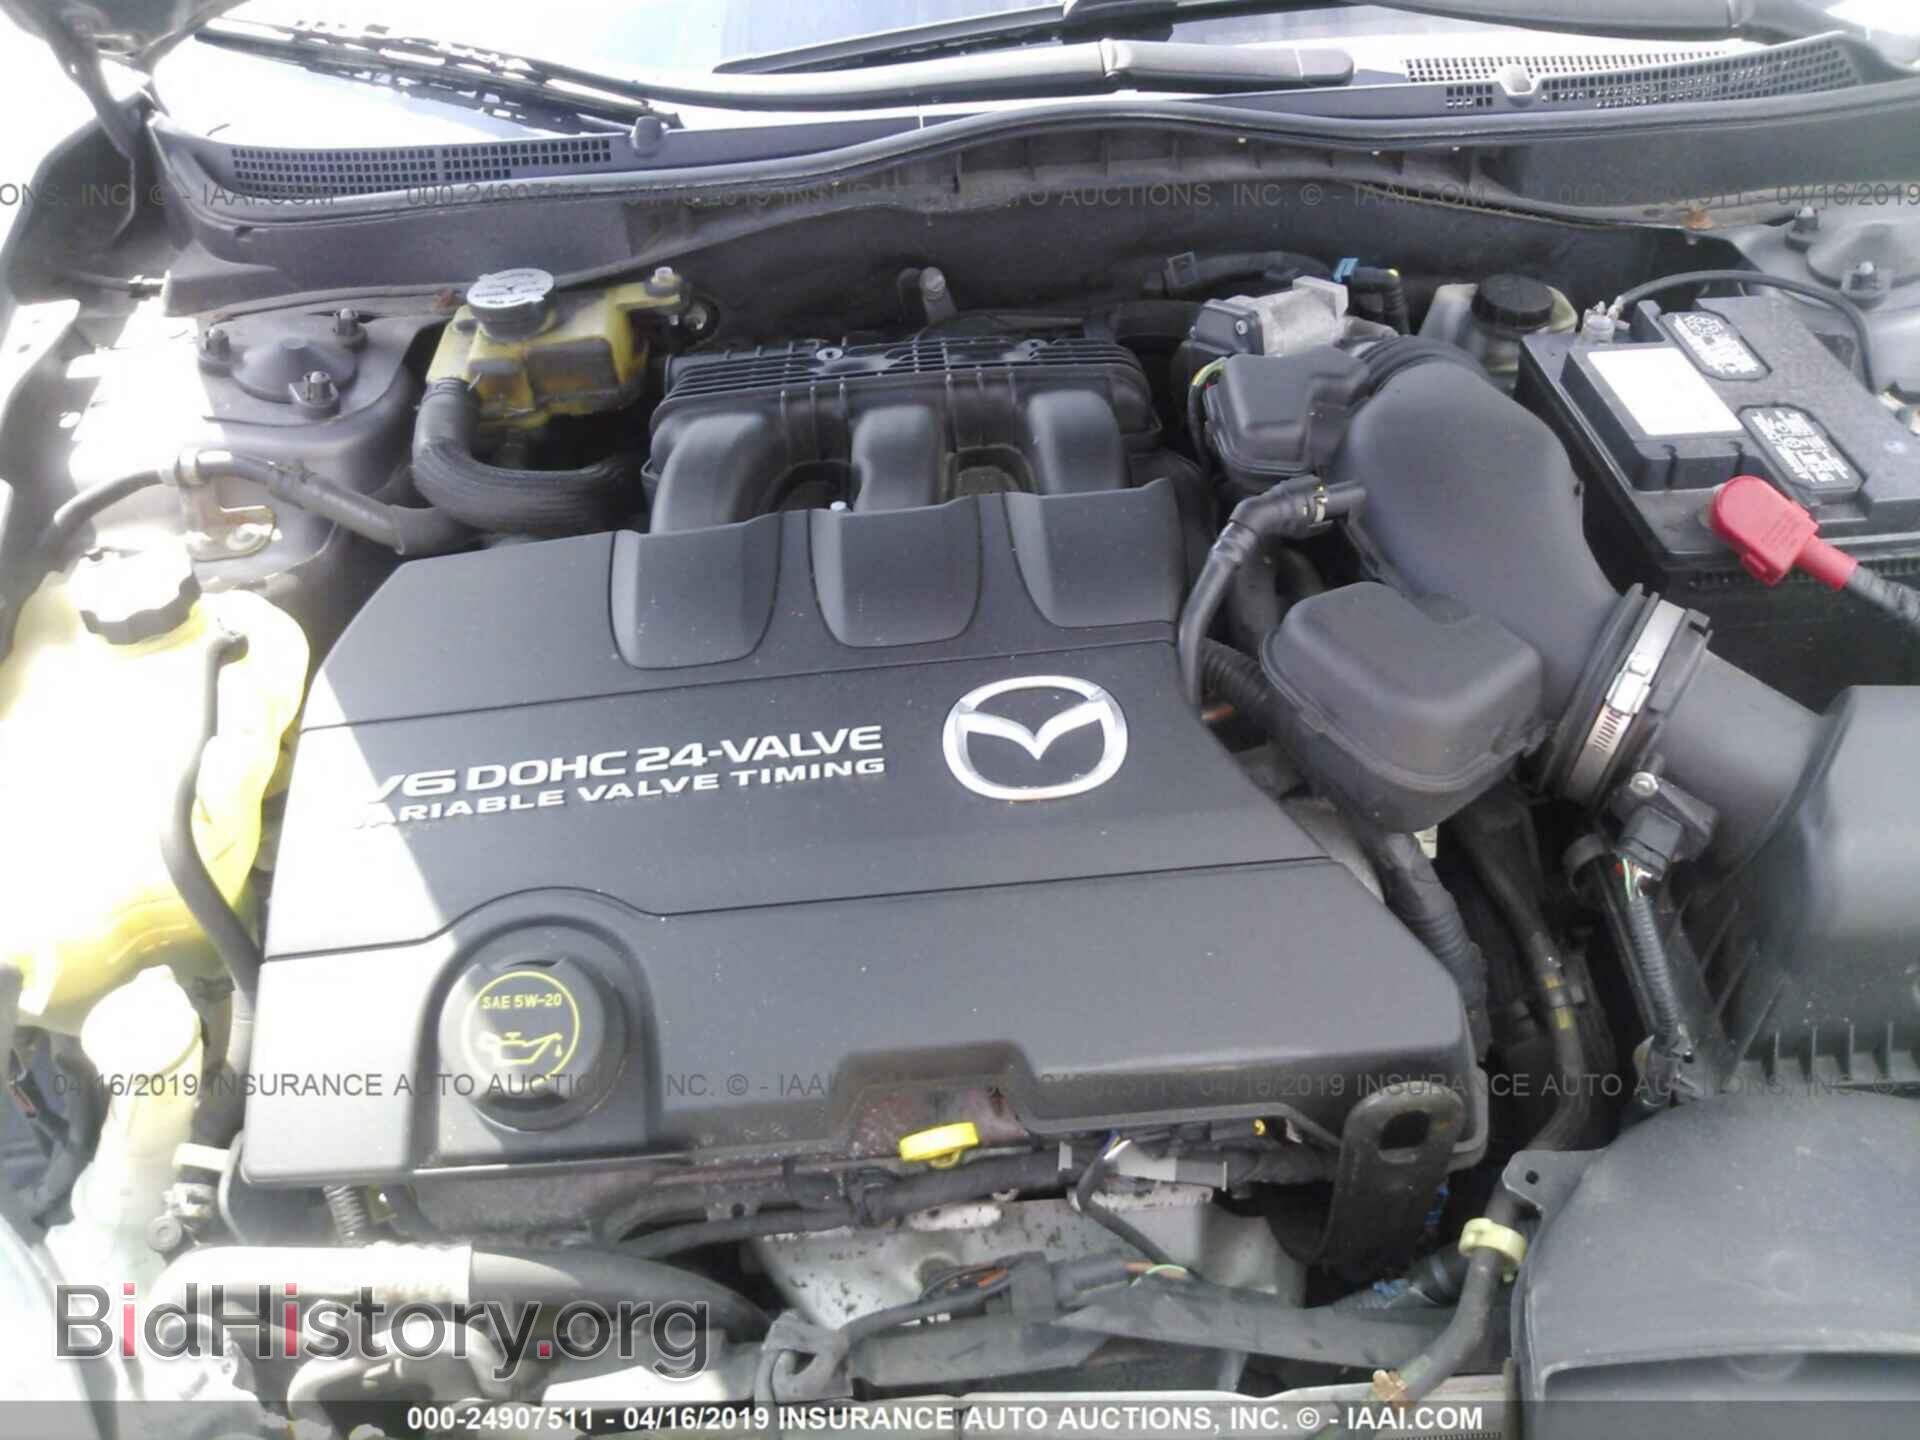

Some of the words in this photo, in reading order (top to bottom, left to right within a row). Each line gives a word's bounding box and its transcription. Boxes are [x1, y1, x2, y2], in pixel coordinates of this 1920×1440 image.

[354, 788, 565, 829] RIABLE
[577, 772, 720, 802] VALVE
[730, 757, 885, 787] TIMING
[466, 750, 628, 793] DOHC
[636, 725, 883, 773] 24-VALVE
[480, 995, 511, 1010] SAE
[513, 992, 563, 1009] 5W-20
